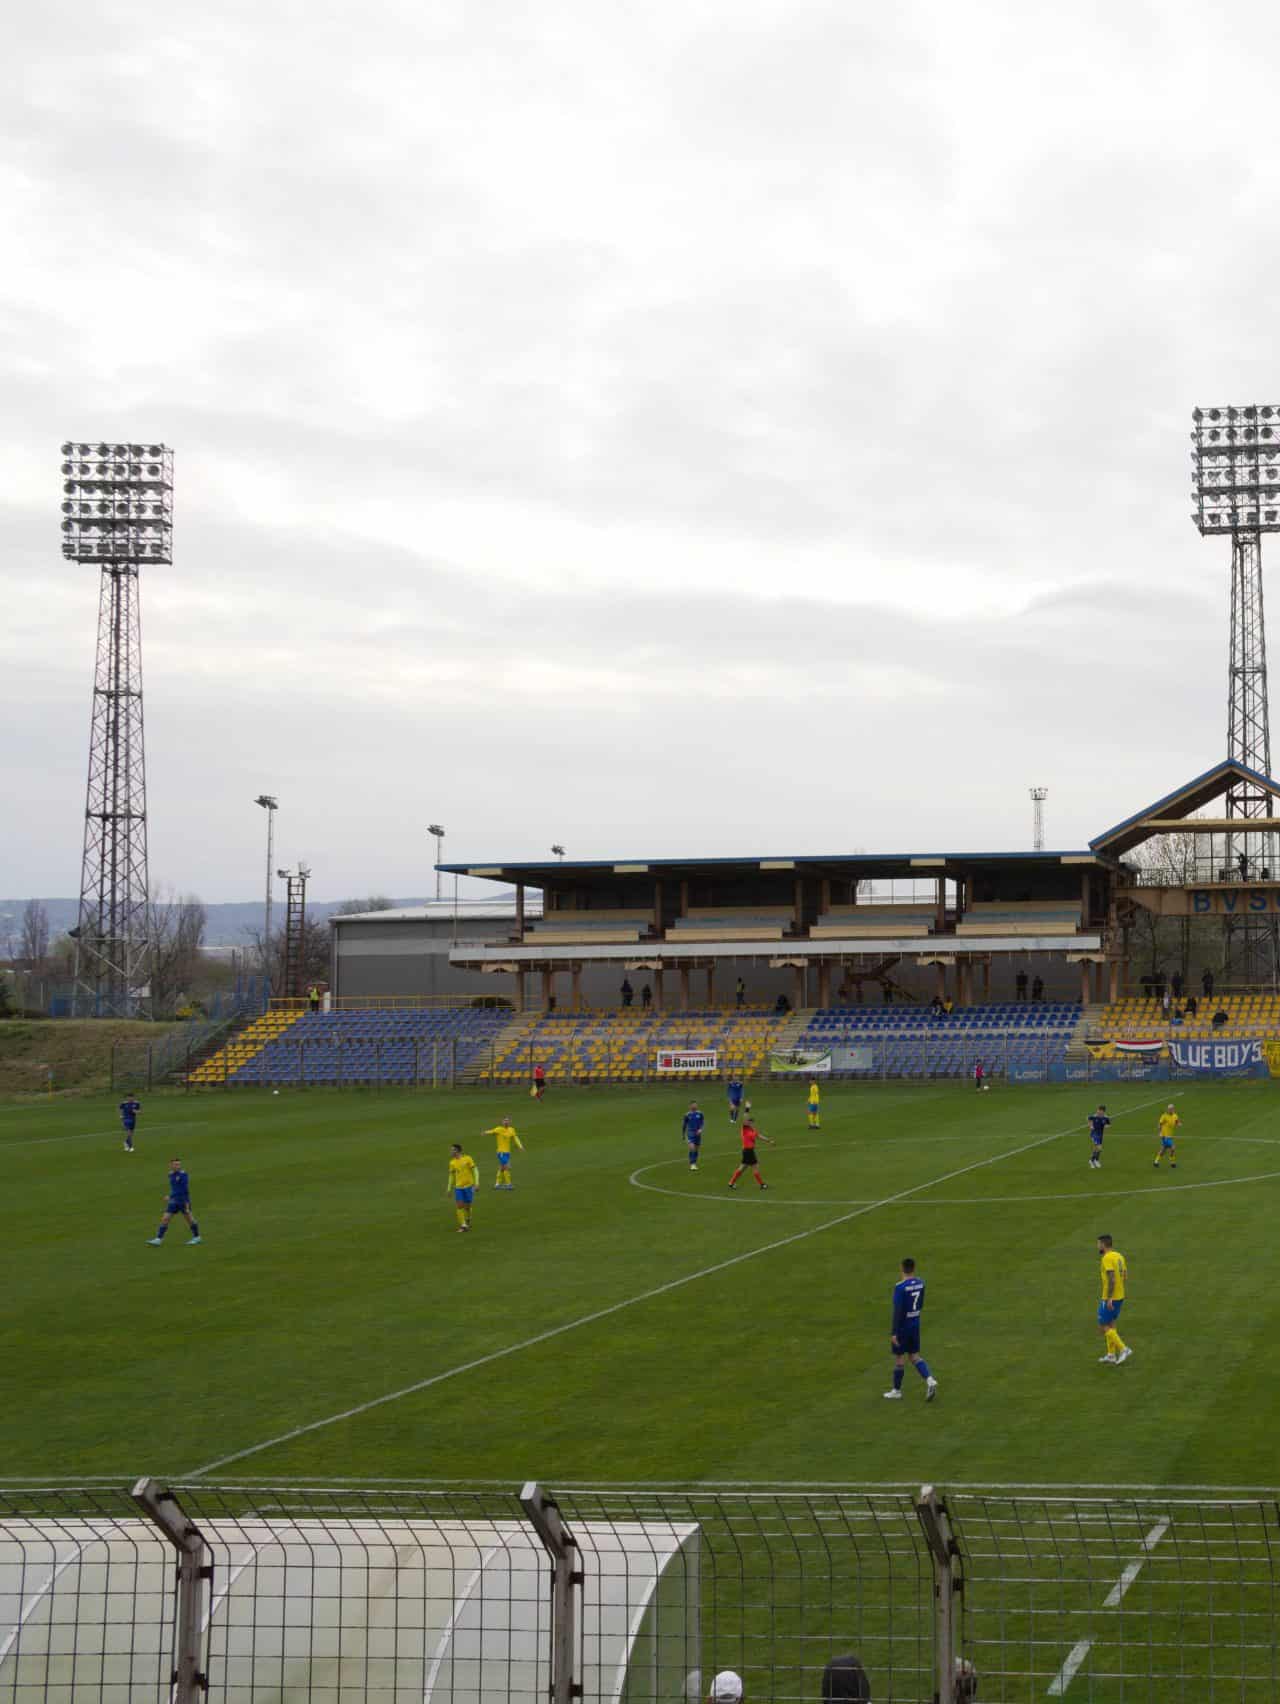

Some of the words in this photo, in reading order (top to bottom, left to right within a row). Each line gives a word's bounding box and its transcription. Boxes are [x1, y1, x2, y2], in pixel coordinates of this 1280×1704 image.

[673, 1057, 714, 1069] Baumit
[1214, 1041, 1263, 1068] BOYS
[911, 1291, 920, 1310] 7
